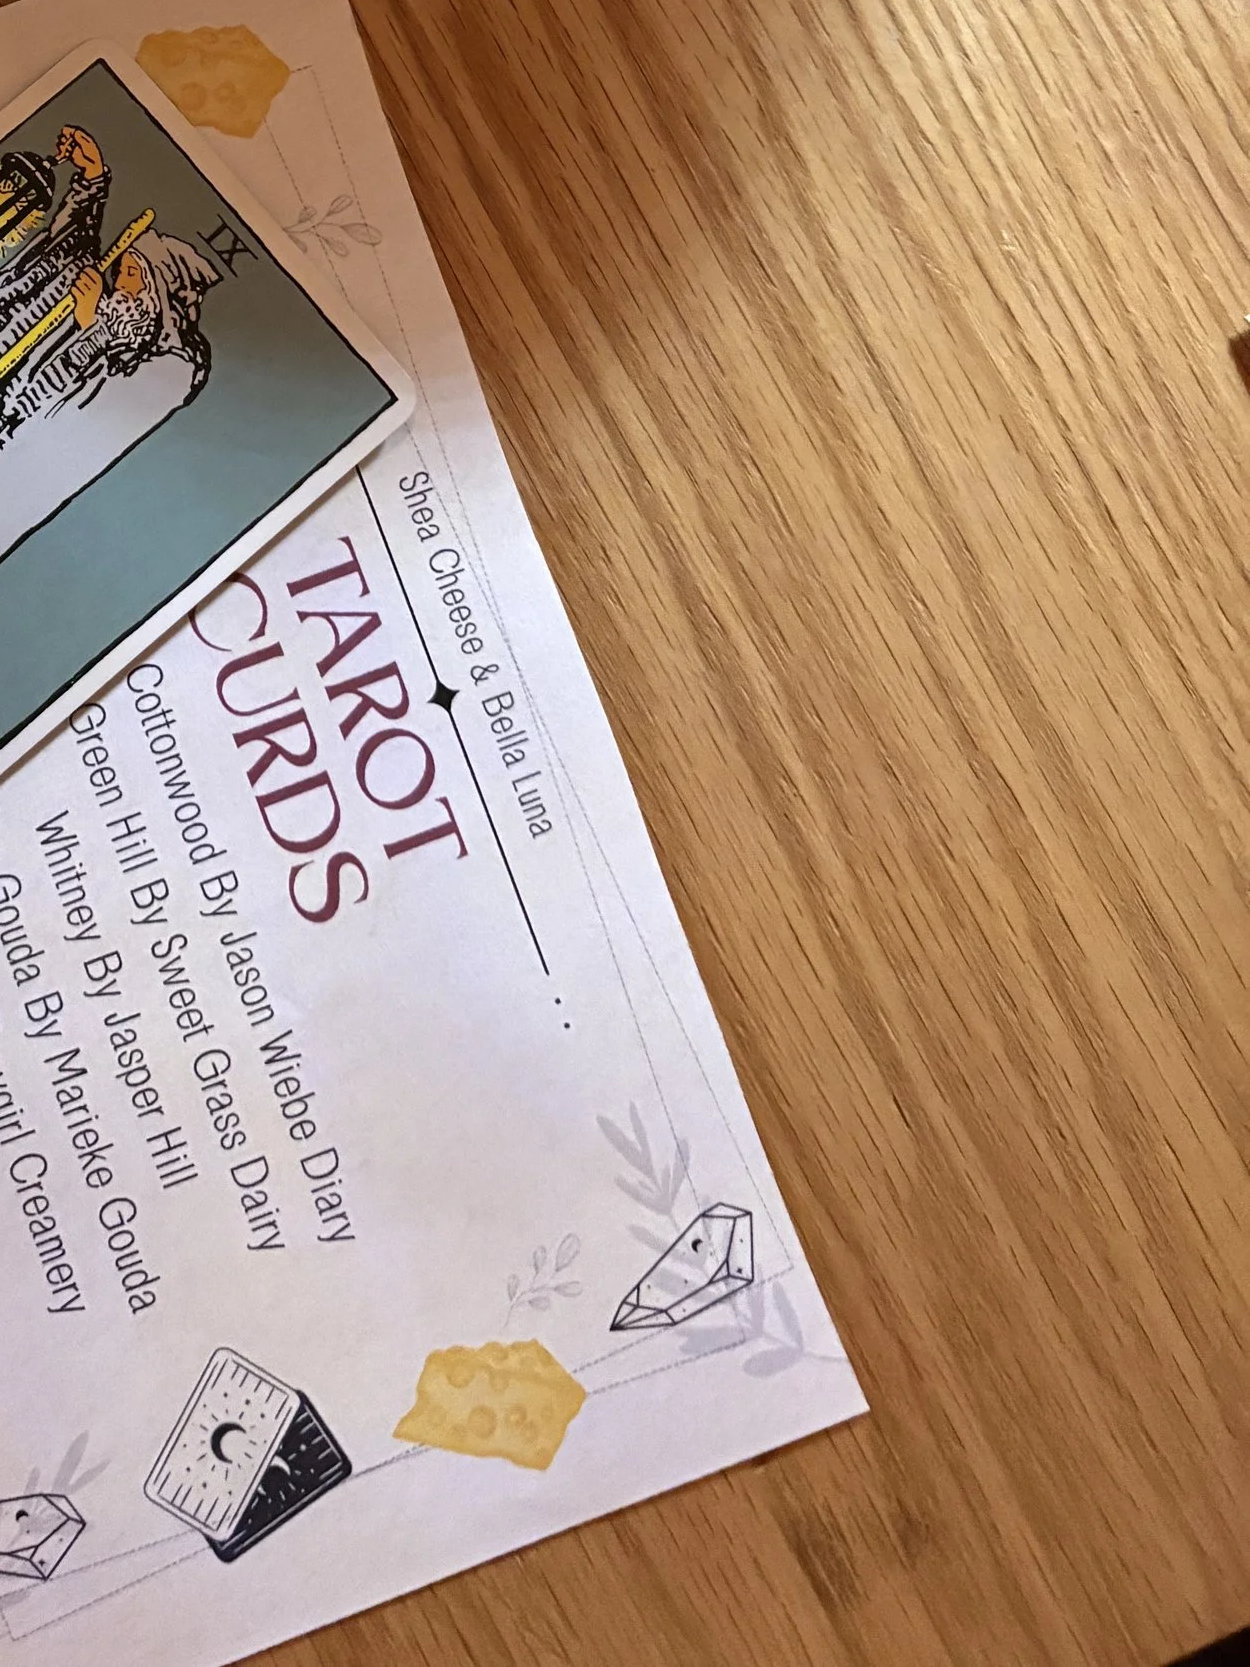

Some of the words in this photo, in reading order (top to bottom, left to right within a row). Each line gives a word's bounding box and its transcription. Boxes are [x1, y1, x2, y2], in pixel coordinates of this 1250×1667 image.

[197, 214, 258, 278] IX
[399, 464, 440, 543] Shea
[429, 549, 483, 654] Cheese
[286, 536, 468, 860] TAROT
[470, 664, 499, 686] &
[69, 702, 124, 808] Green
[188, 572, 370, 924] CURDS
[481, 691, 529, 769] Bella
[106, 812, 158, 873] Hill
[512, 771, 552, 839] Luna
[126, 663, 227, 865] Cottonwood
[199, 870, 238, 917] By
[220, 932, 274, 1027] Jason
[259, 1029, 316, 1141] Wiebe
[300, 1147, 355, 1242] Diary
[130, 878, 169, 925] By
[35, 810, 101, 941] Whitney
[83, 950, 122, 998] By
[104, 1013, 164, 1118] Jasper
[146, 1126, 198, 1189] Hill
[151, 934, 214, 1043] Sweet
[194, 1049, 246, 1150] Grass
[24, 991, 63, 1038] By
[44, 1048, 114, 1188] Marieke
[99, 1197, 160, 1315] Gouda
[230, 1155, 285, 1251] Dairy
[10, 1153, 85, 1313] Creamery
